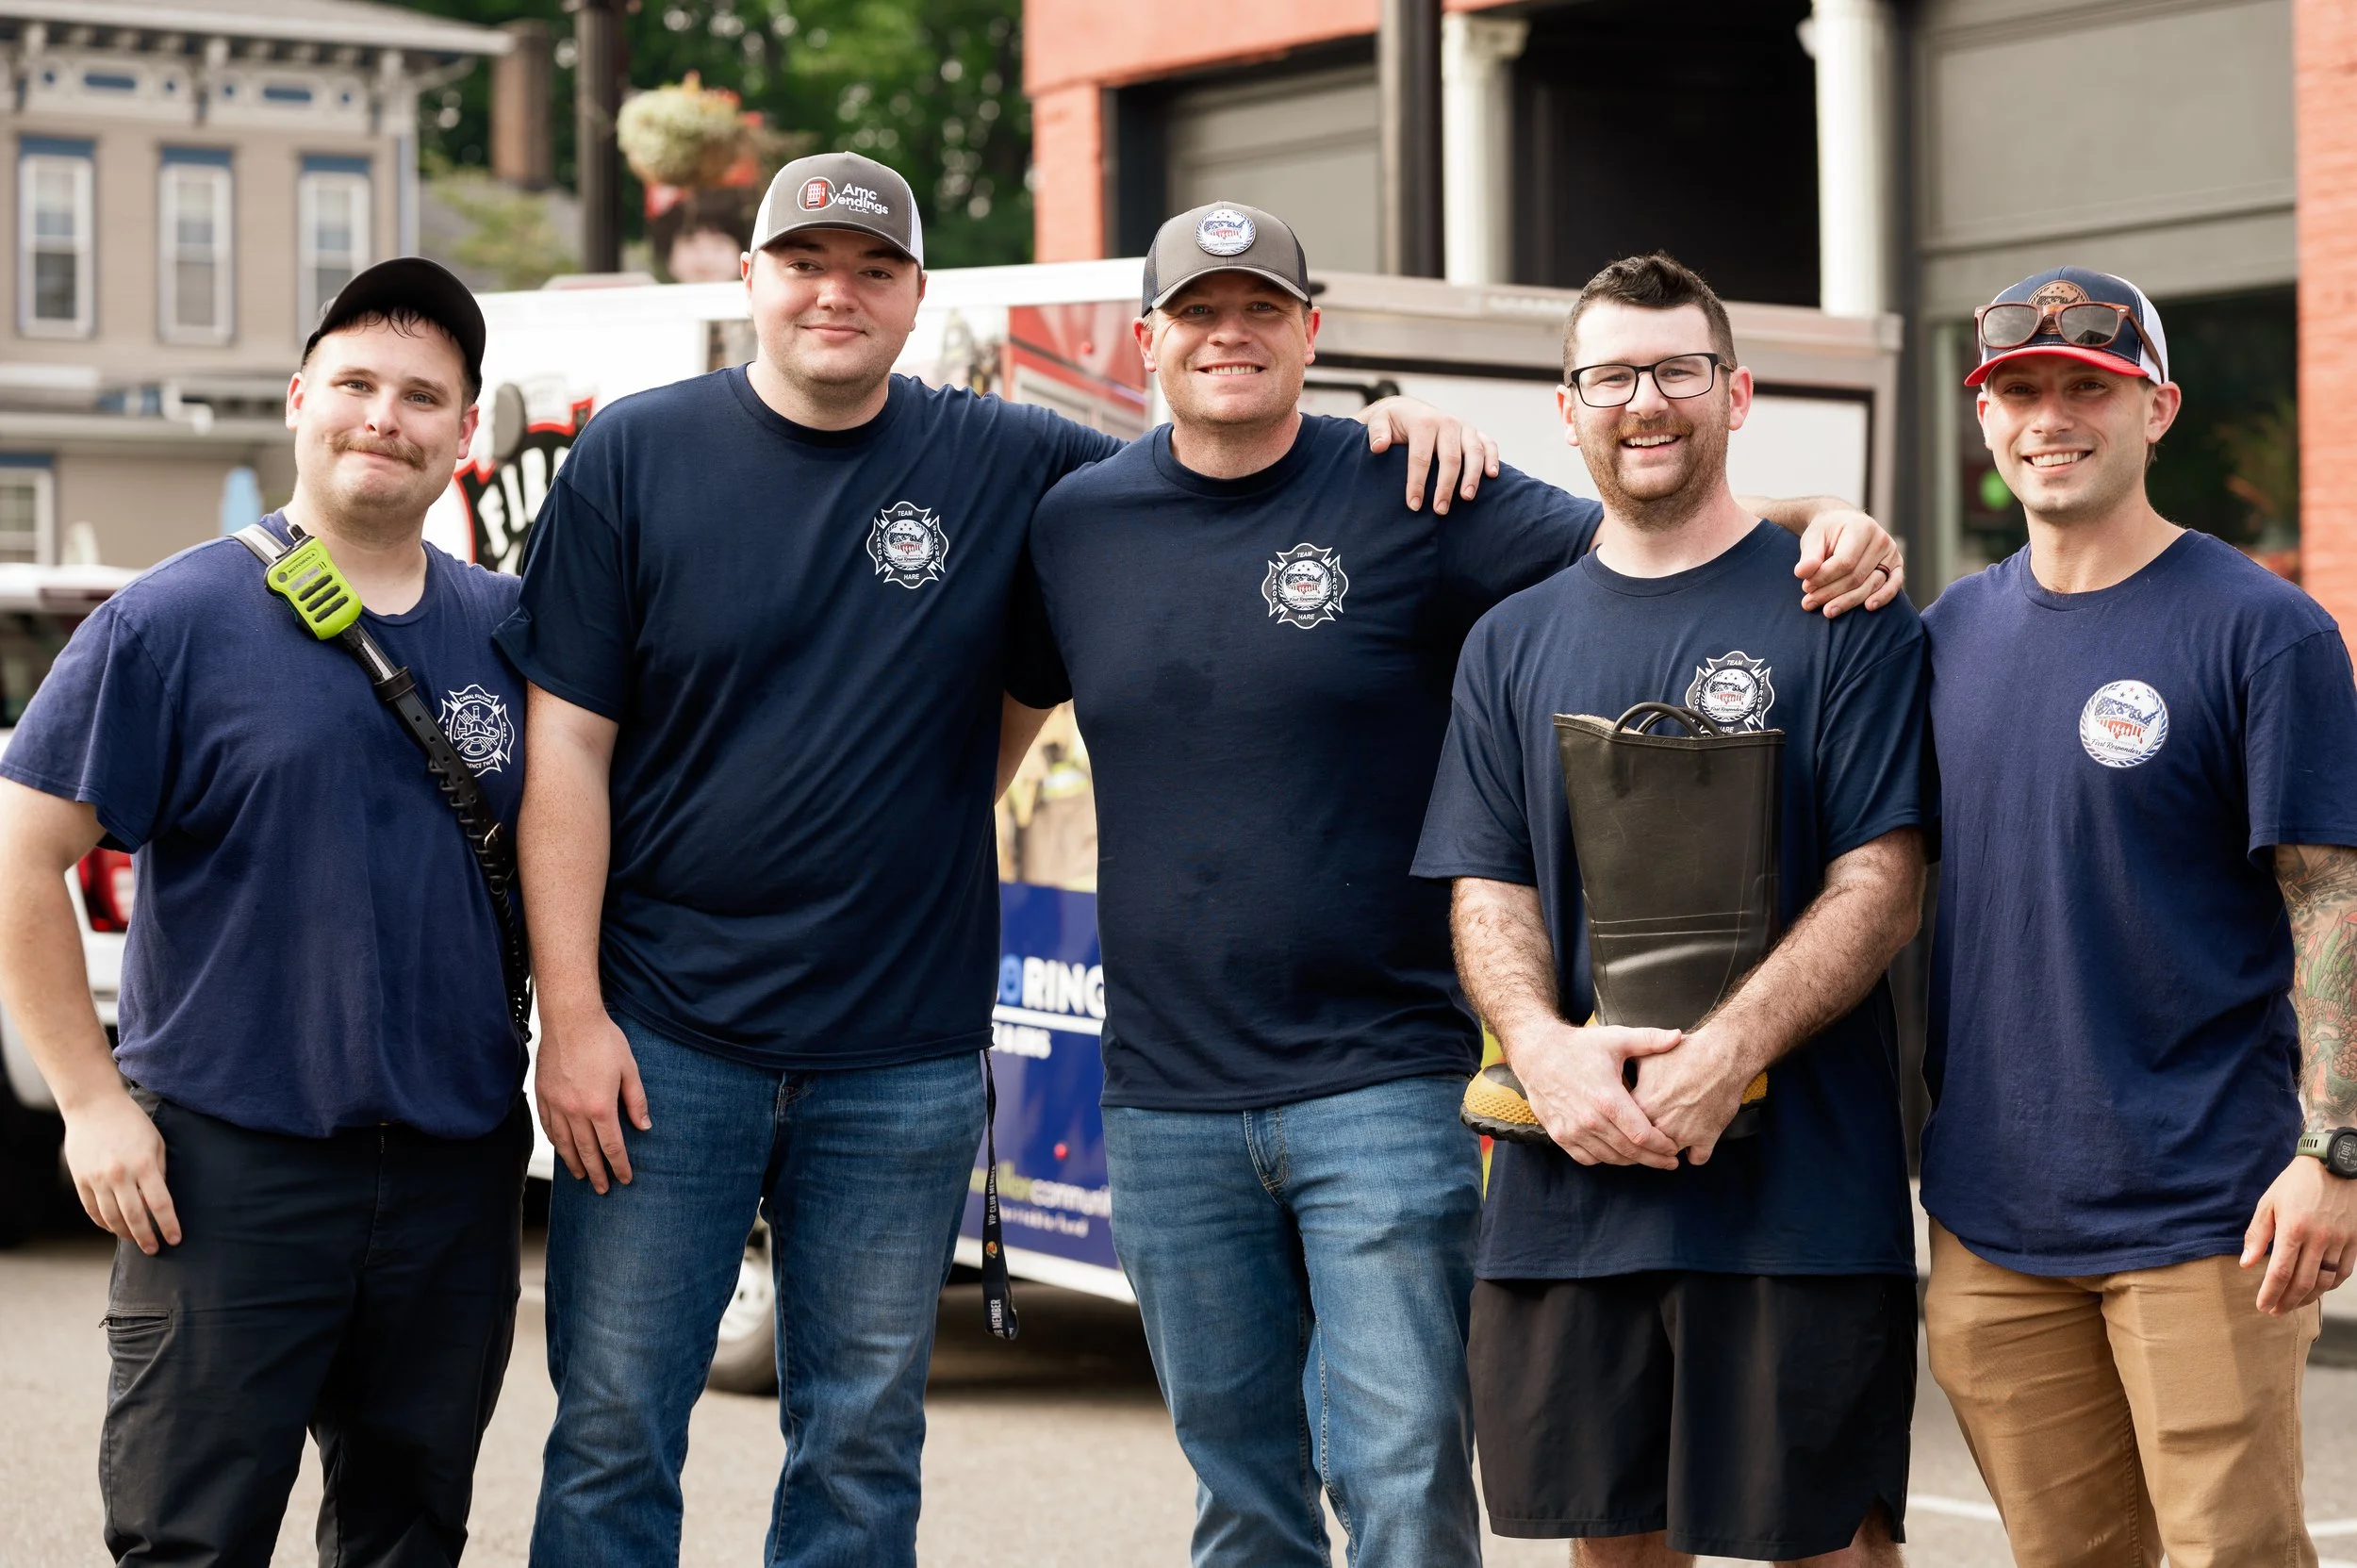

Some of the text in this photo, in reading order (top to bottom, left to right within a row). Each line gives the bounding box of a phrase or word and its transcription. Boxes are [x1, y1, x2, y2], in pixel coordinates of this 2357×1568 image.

[842, 183, 877, 200] Amc
[829, 192, 889, 215] Vendings
[476, 446, 569, 558] FIR
[932, 525, 941, 563] STRONG
[288, 553, 315, 573] MOTOROLA
[474, 694, 492, 703] FULTON
[1756, 676, 1766, 718] STRONG
[2091, 738, 2105, 748] First
[2105, 741, 2142, 755] Responders
[483, 758, 494, 767] TWP
[997, 954, 1106, 1019] ORING
[988, 1213, 997, 1225] VIP
[991, 1299, 1003, 1330] MEMBER
